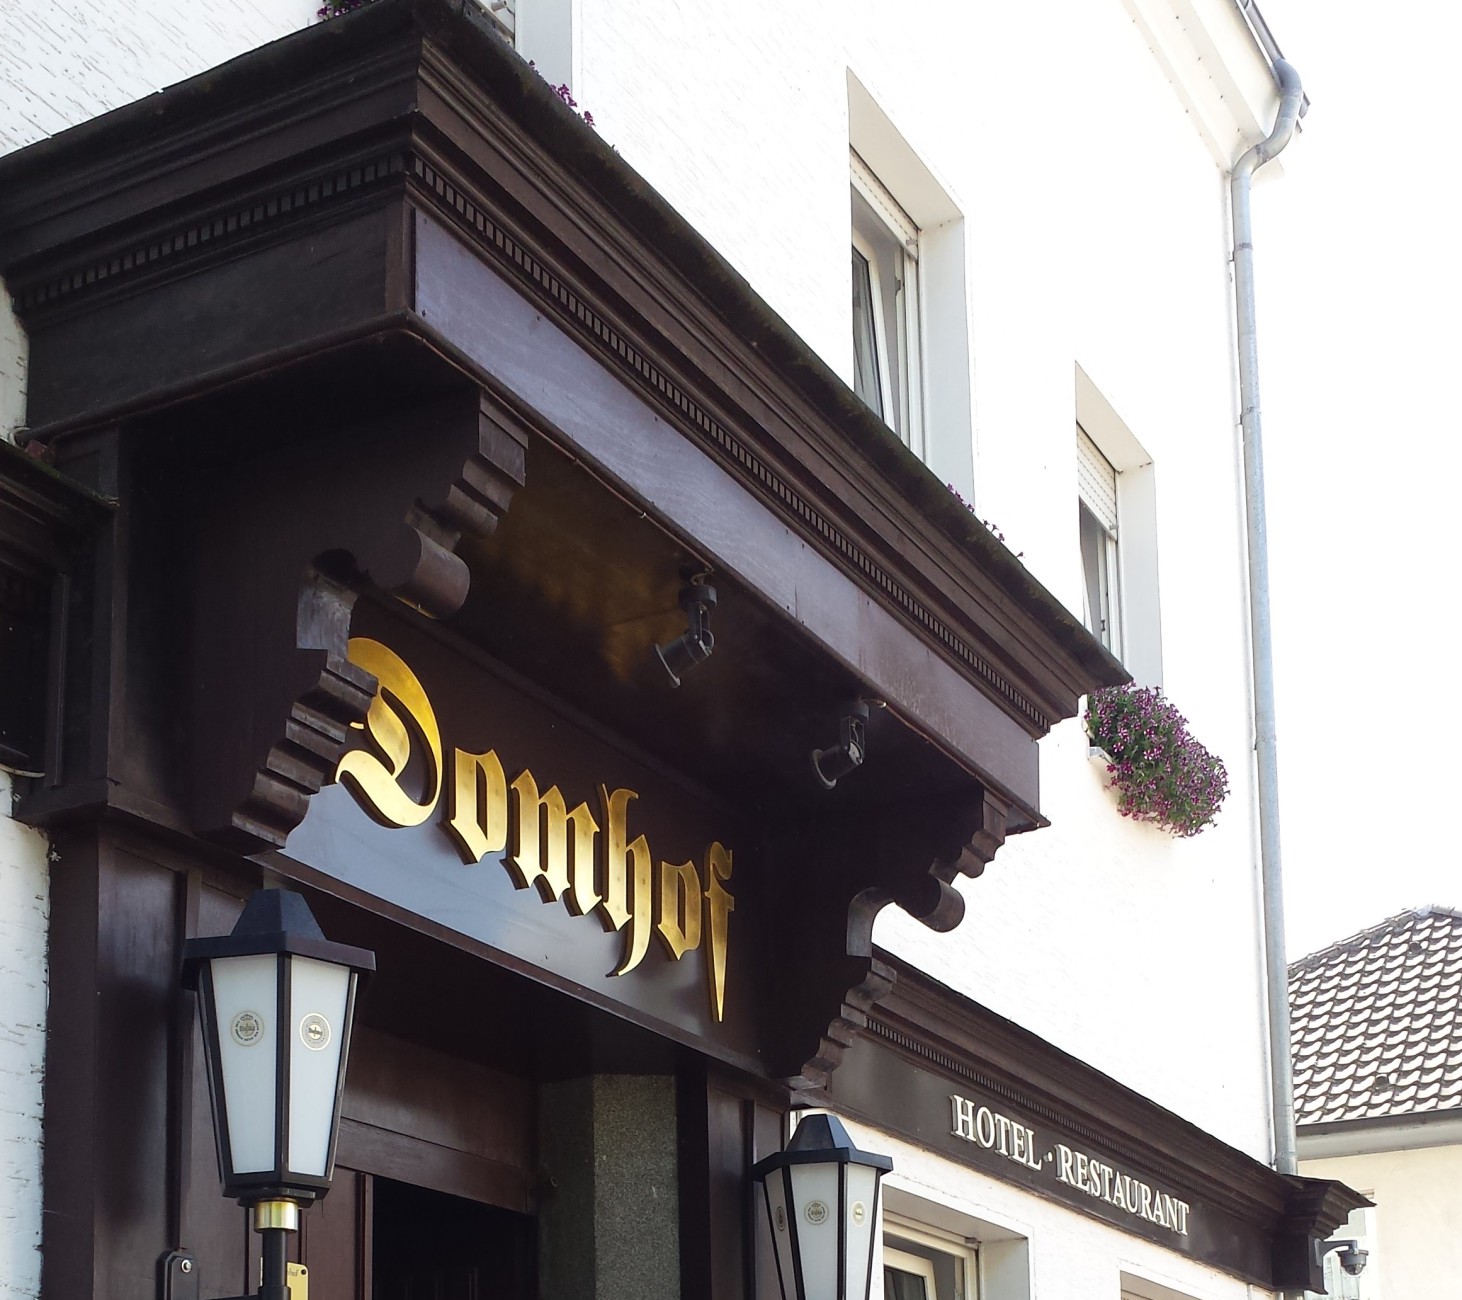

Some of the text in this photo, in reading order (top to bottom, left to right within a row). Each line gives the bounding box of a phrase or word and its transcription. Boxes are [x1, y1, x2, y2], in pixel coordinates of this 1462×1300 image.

[334, 636, 735, 1023] Domhof
[951, 1094, 1190, 1236] HOTEL RESTAURANT
